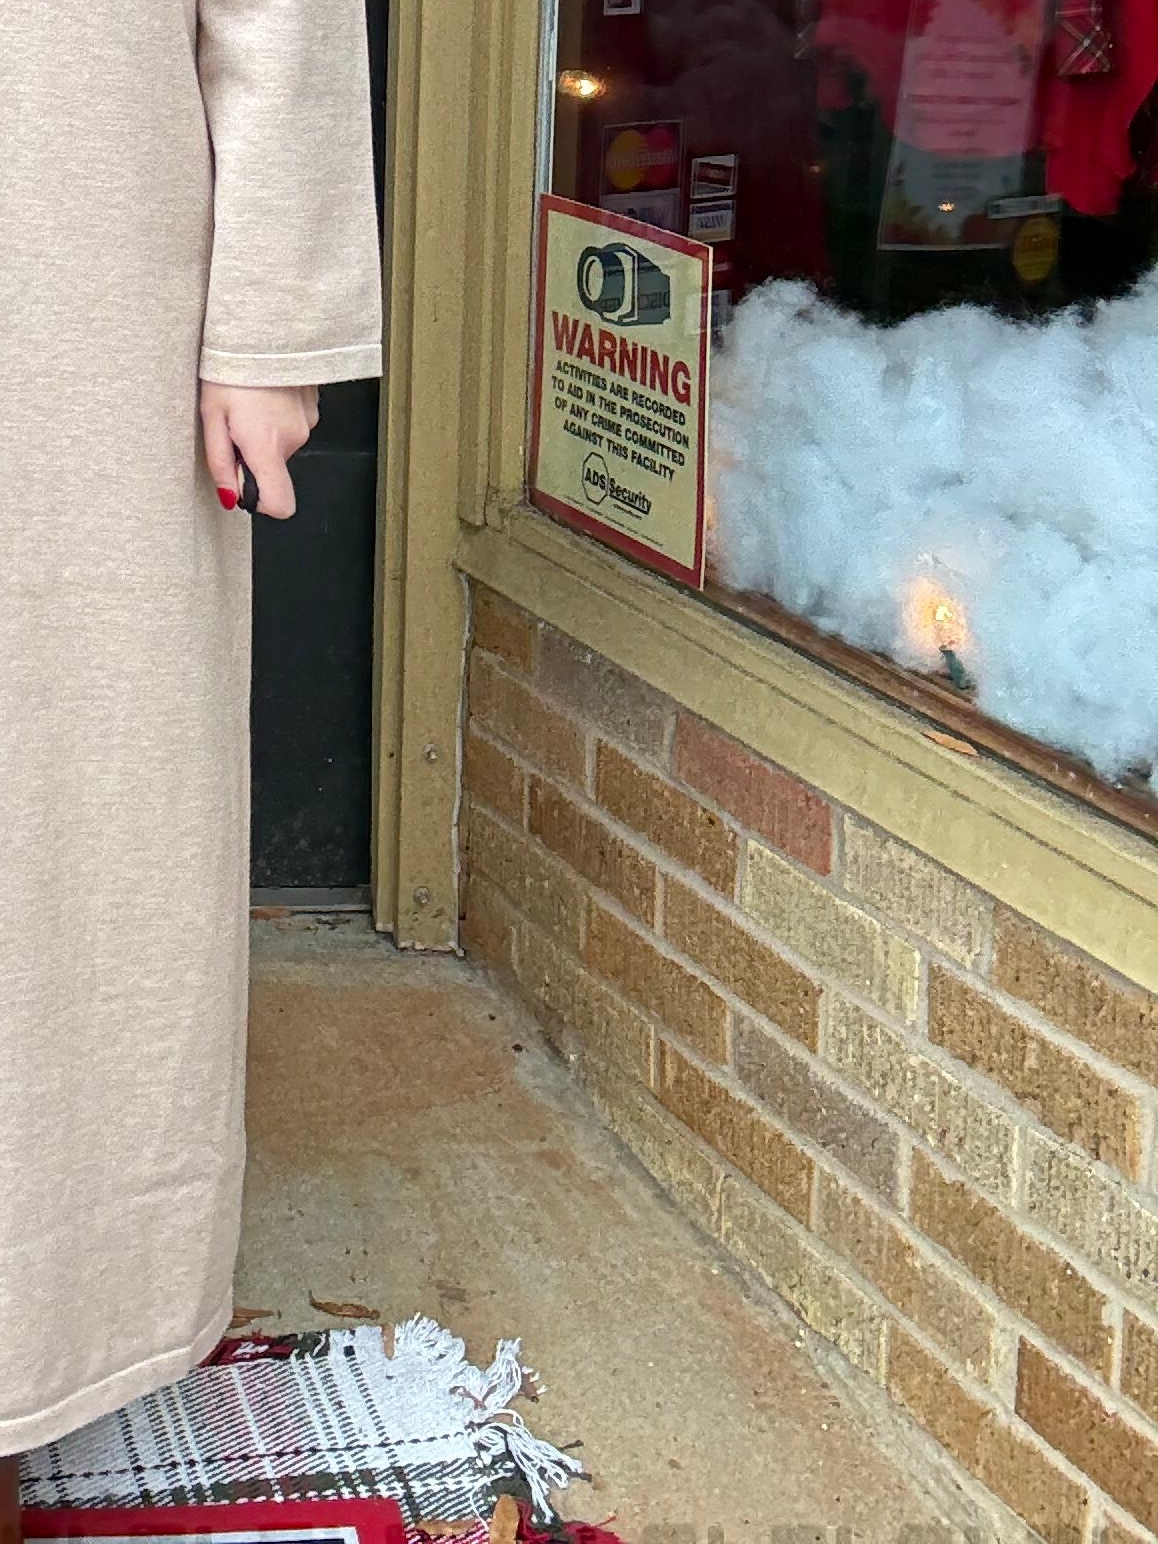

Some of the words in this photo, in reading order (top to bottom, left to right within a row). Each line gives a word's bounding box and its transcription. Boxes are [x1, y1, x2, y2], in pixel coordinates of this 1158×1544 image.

[551, 310, 691, 407] WARNING
[555, 359, 607, 392] ACTIVITIES
[609, 381, 629, 401] ARE
[631, 392, 686, 426] RECORDED
[551, 375, 565, 391] TO
[567, 382, 584, 400] AID
[585, 389, 596, 407] IN
[599, 395, 617, 415] THE
[619, 405, 690, 449] PROSECUTION
[554, 396, 568, 411] OF
[569, 403, 590, 422] ANY
[591, 412, 622, 438] CRIME
[624, 427, 685, 467] COMMITTED
[563, 419, 605, 449] AGAINST
[606, 438, 629, 460] THIS
[630, 449, 676, 484] FACILITY
[584, 467, 607, 491] ADS
[608, 477, 653, 511] Security
